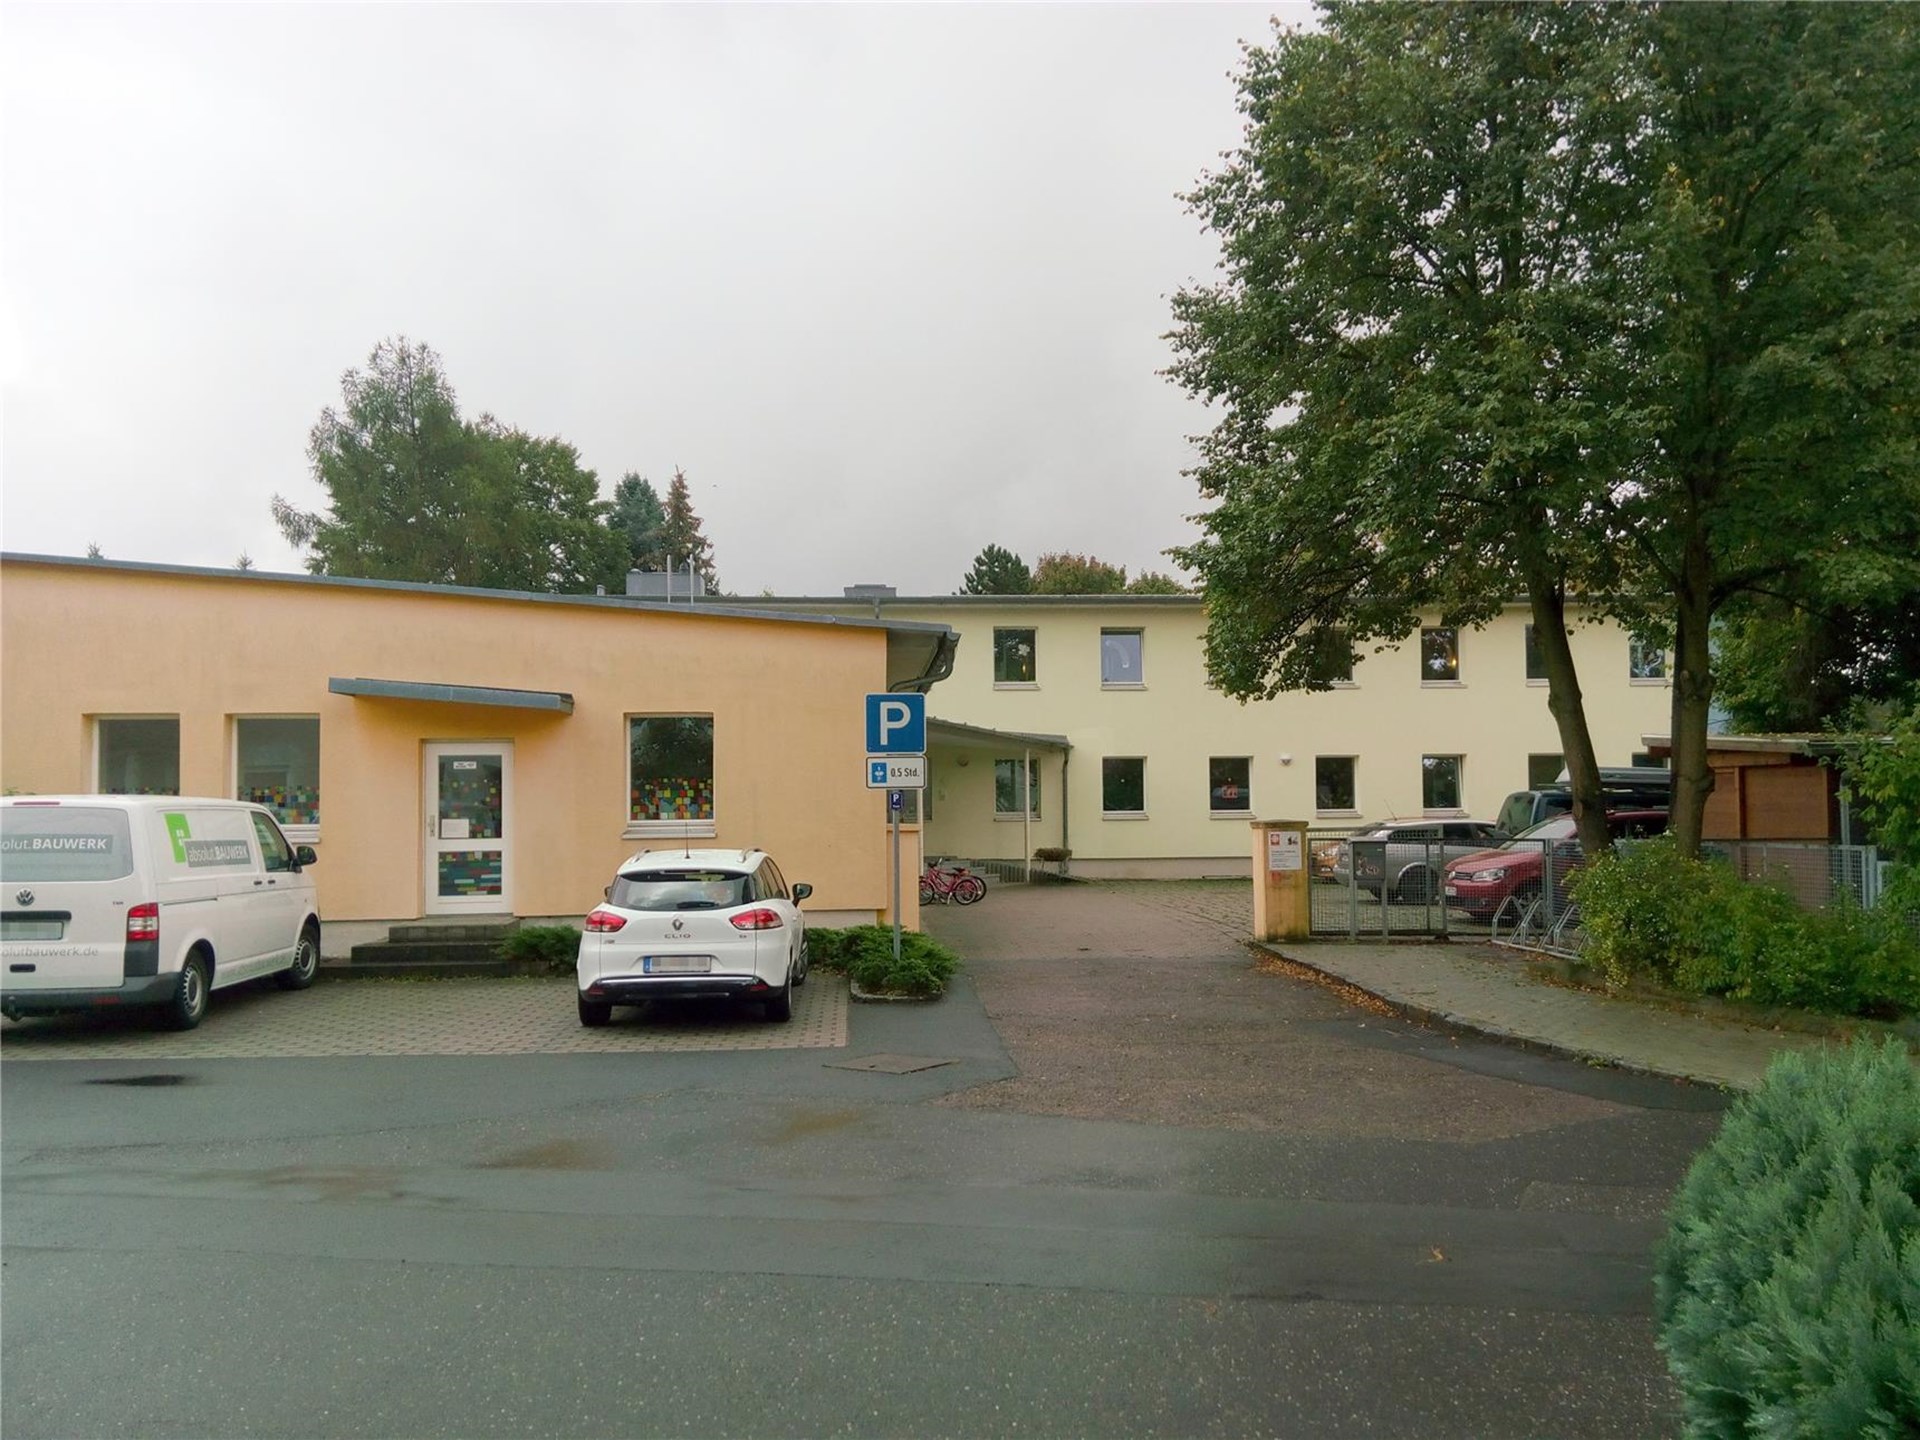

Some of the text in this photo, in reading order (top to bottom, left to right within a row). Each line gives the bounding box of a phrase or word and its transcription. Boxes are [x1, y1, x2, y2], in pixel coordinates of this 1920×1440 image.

[880, 701, 911, 745] P
[904, 767, 920, 778] Std.
[893, 793, 900, 802] P
[0, 838, 107, 850] olut.BAUWERK
[188, 845, 249, 862] absolut.BAUWERK
[0, 946, 99, 957] olutbauwerk.de
